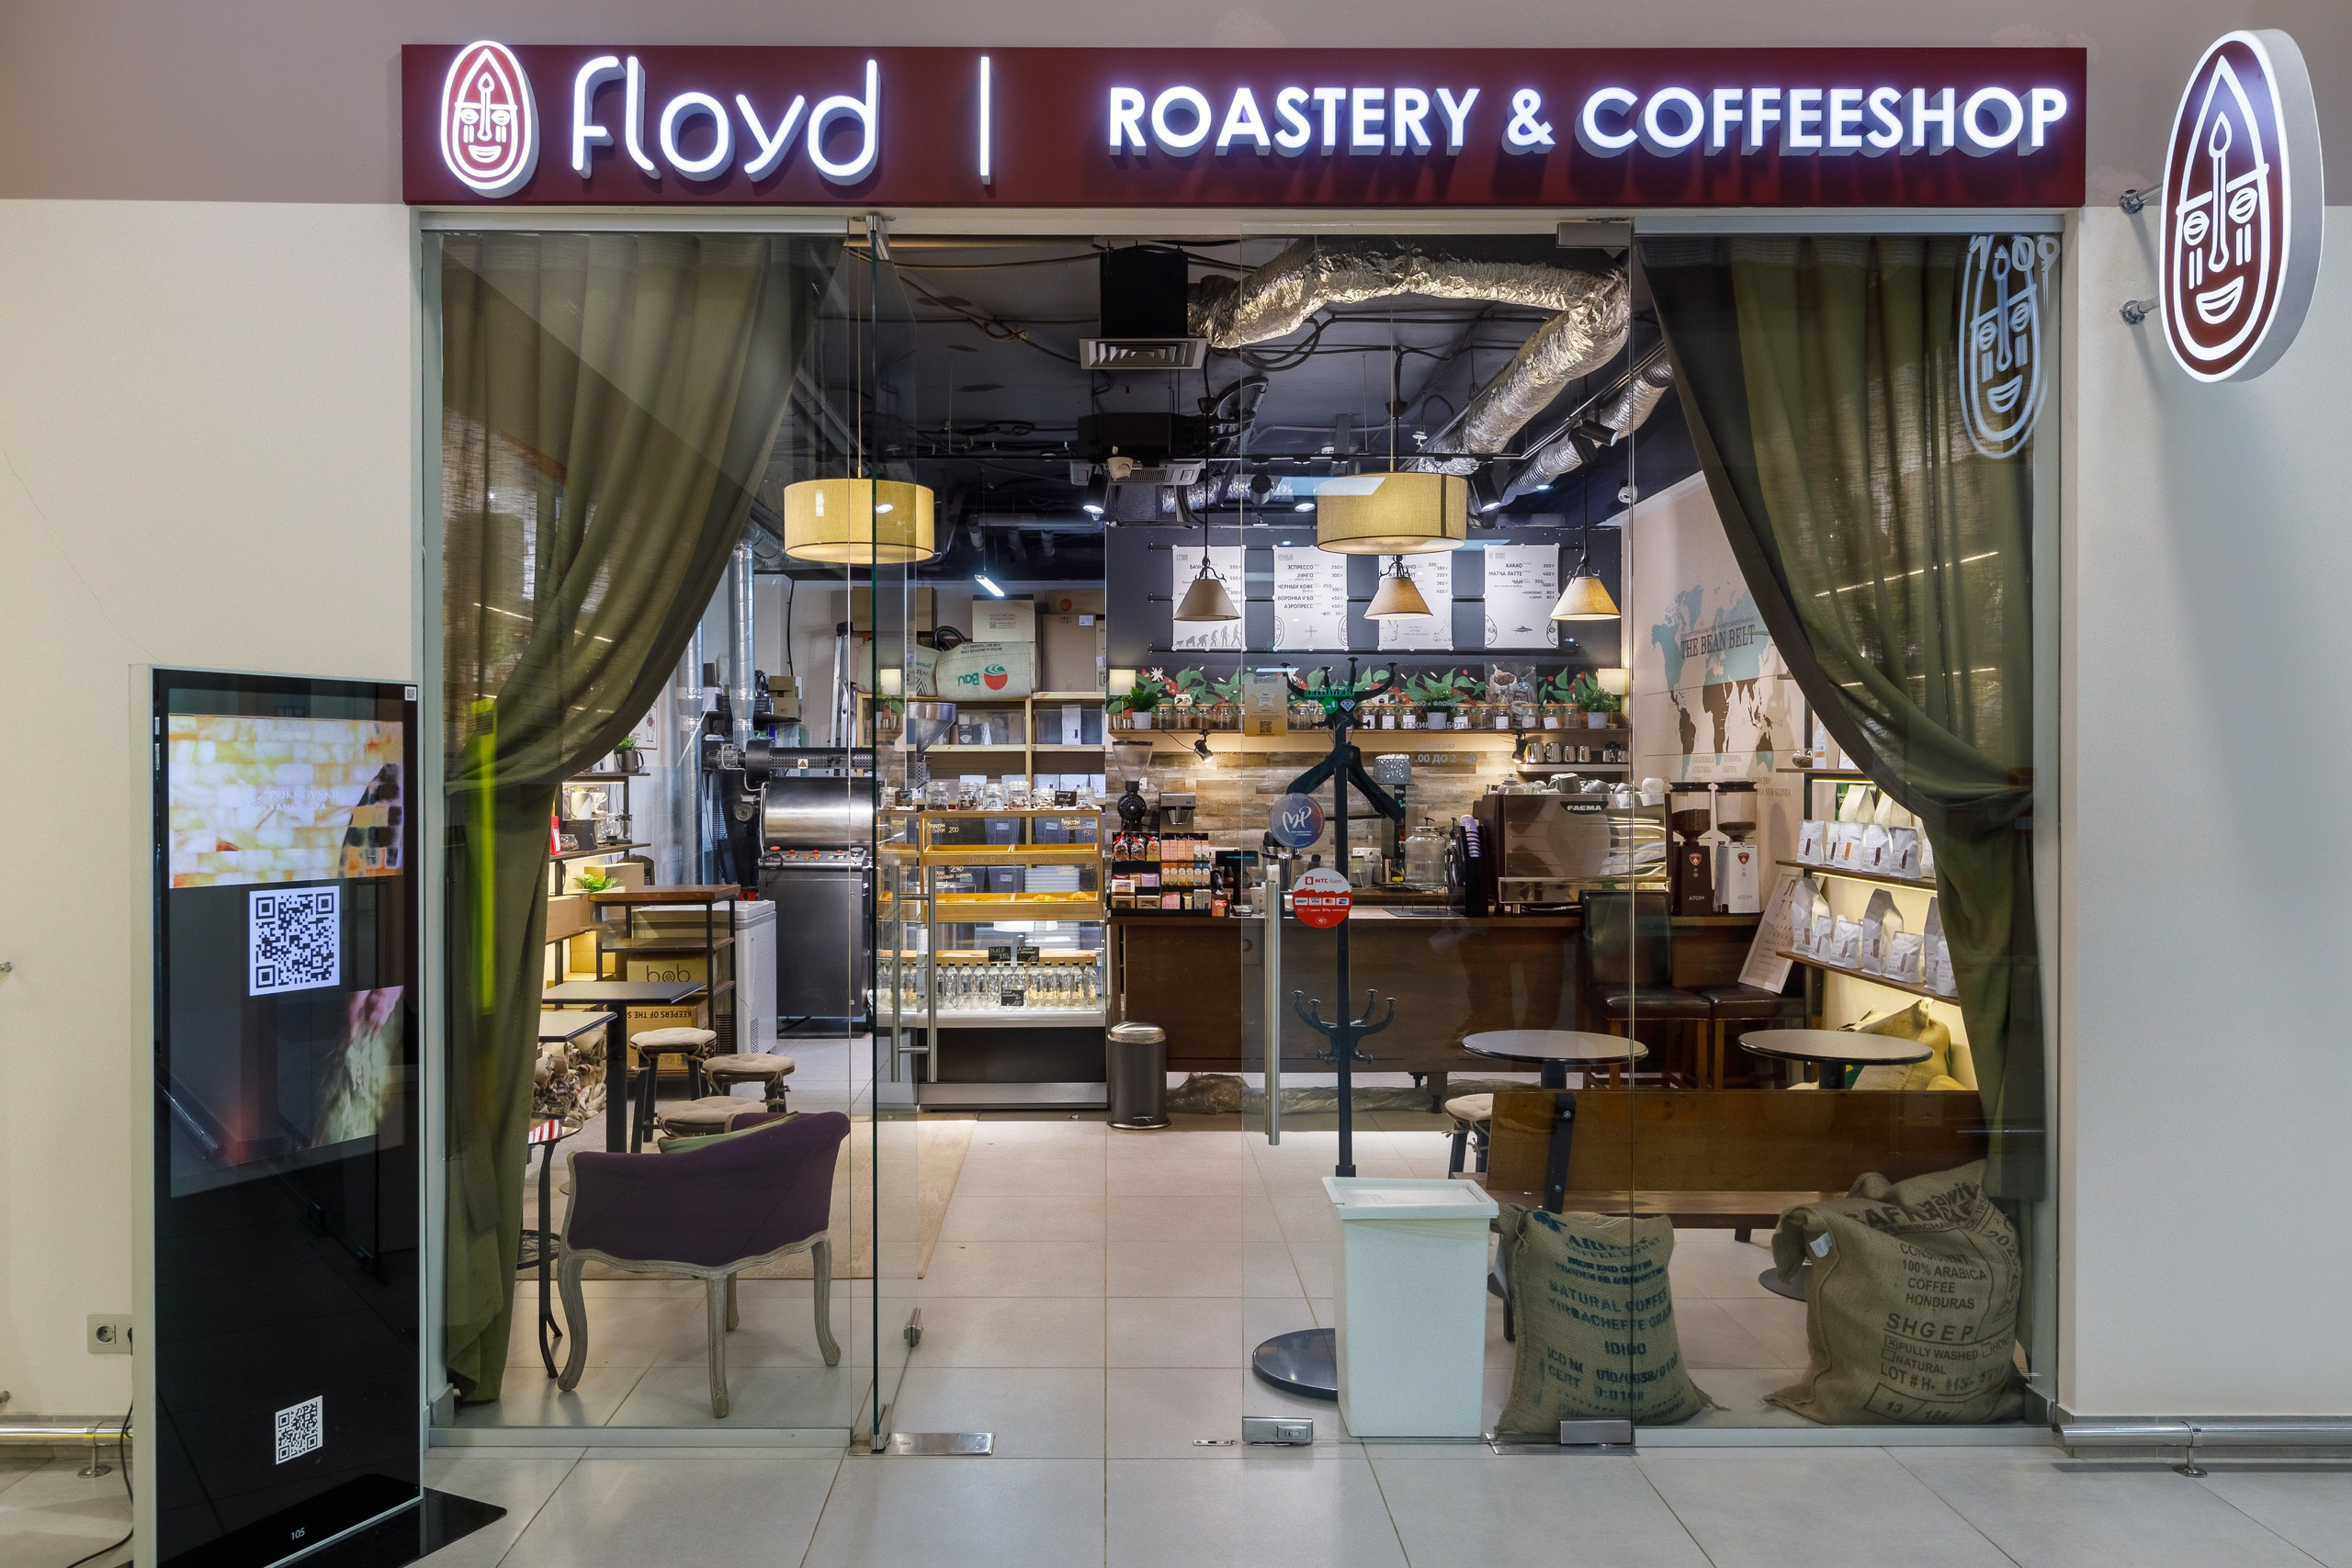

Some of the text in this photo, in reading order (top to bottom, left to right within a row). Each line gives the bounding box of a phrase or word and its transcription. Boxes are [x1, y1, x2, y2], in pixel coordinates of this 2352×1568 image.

[571, 55, 879, 181] floyd
[1110, 86, 2067, 154] ROASTERY & COFFEESHOP
[1680, 637, 1699, 660] THE
[1701, 631, 1727, 655] BEAN
[1728, 625, 1756, 649] BELT
[1432, 754, 1448, 764] ДО
[646, 964, 691, 982] bob
[661, 1010, 692, 1019] KEEPERS
[1902, 1259, 1987, 1280] 100% ARABICA
[1907, 1277, 1956, 1293] COFFEE
[1548, 1280, 1668, 1313] NATURAL COFFEE
[1905, 1292, 1975, 1310] HONDURAS
[1548, 1298, 1645, 1330] YIRACHEFFE
[1898, 1342, 1931, 1358] FULLY
[1933, 1348, 1979, 1361] WASHED
[1895, 1355, 1947, 1375] NATURAL
[1881, 1362, 1906, 1383] LOT
[1909, 1377, 1917, 1388] #
[1886, 1402, 1904, 1414] 13
[290, 1528, 306, 1541] 105
